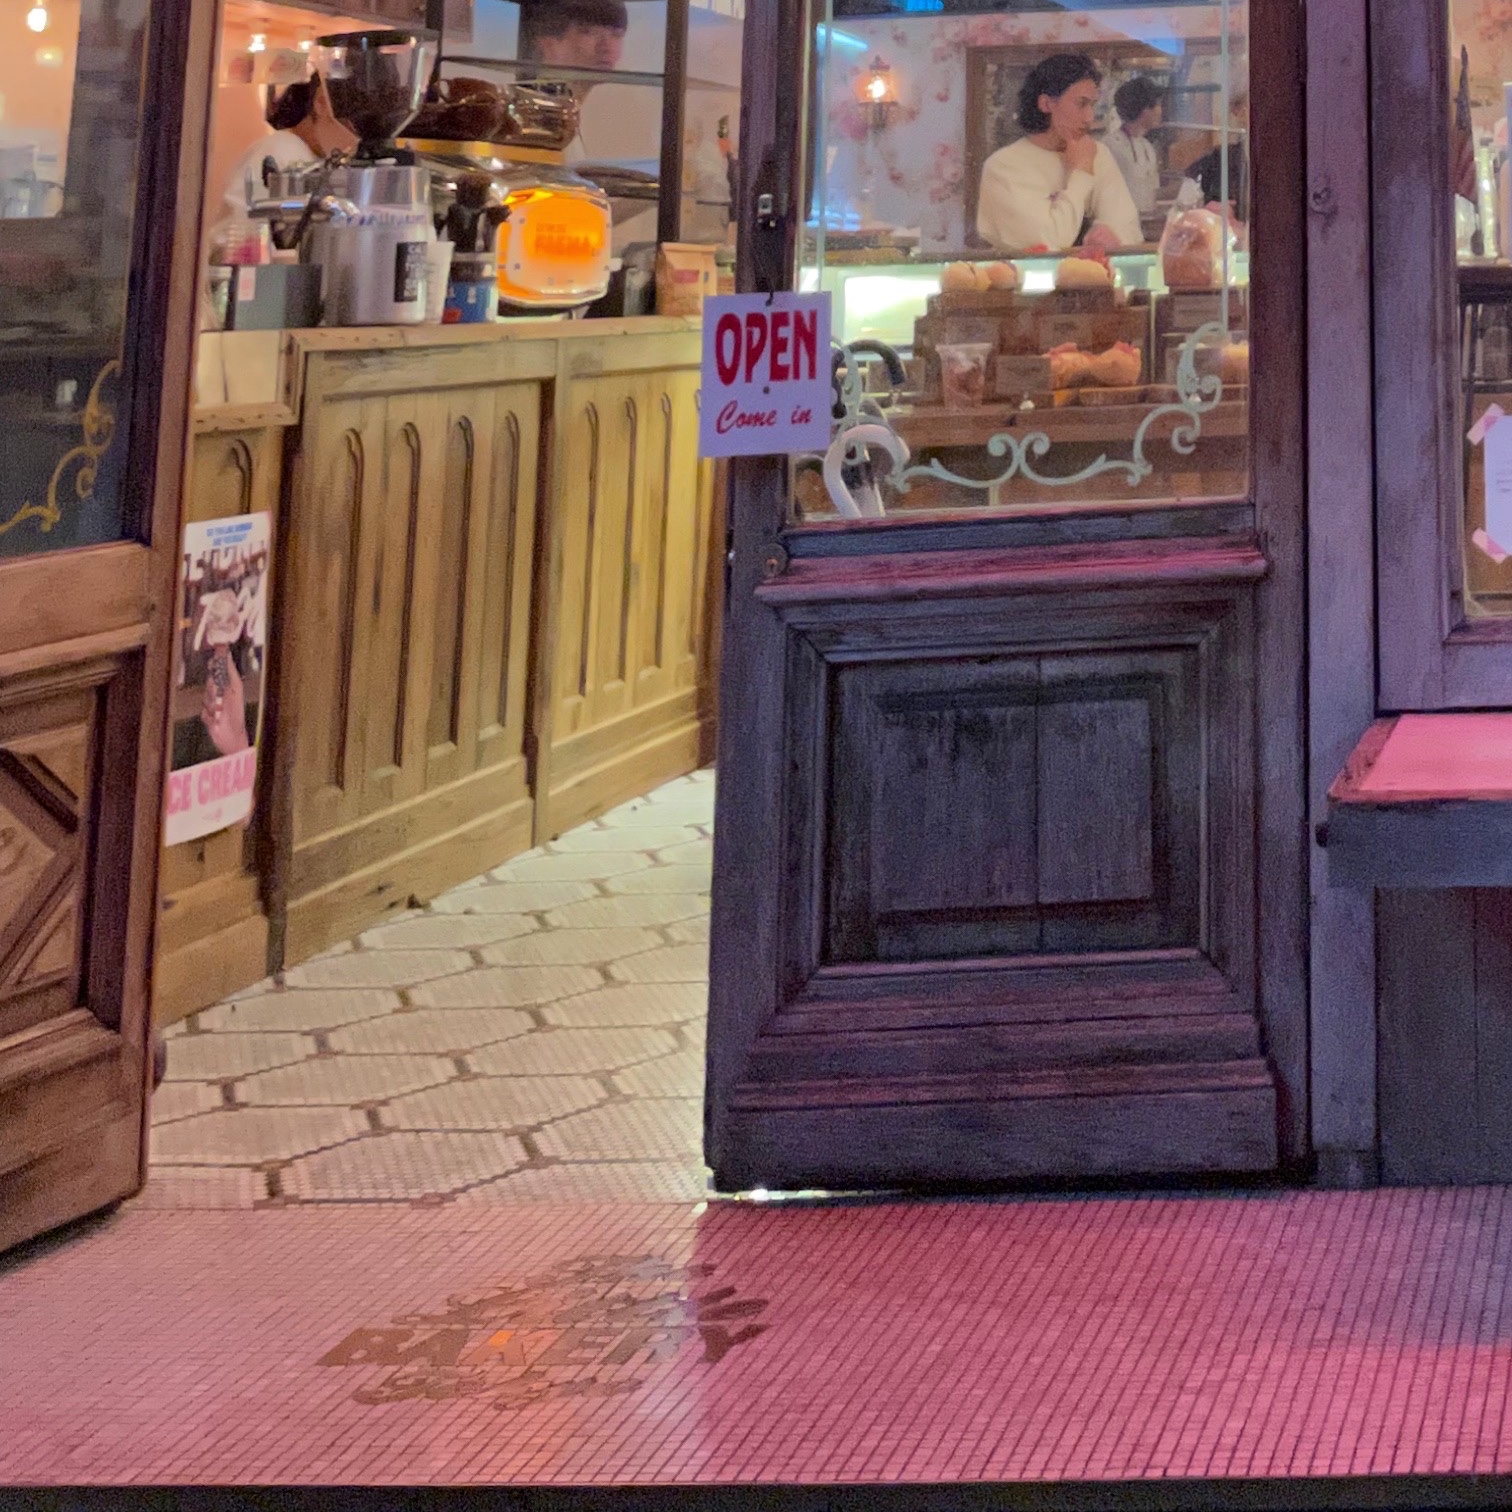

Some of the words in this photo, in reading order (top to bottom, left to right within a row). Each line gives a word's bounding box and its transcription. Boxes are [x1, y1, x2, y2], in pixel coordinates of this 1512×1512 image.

[715, 310, 818, 386] OPEN
[716, 400, 777, 434] Come
[790, 405, 813, 425] in
